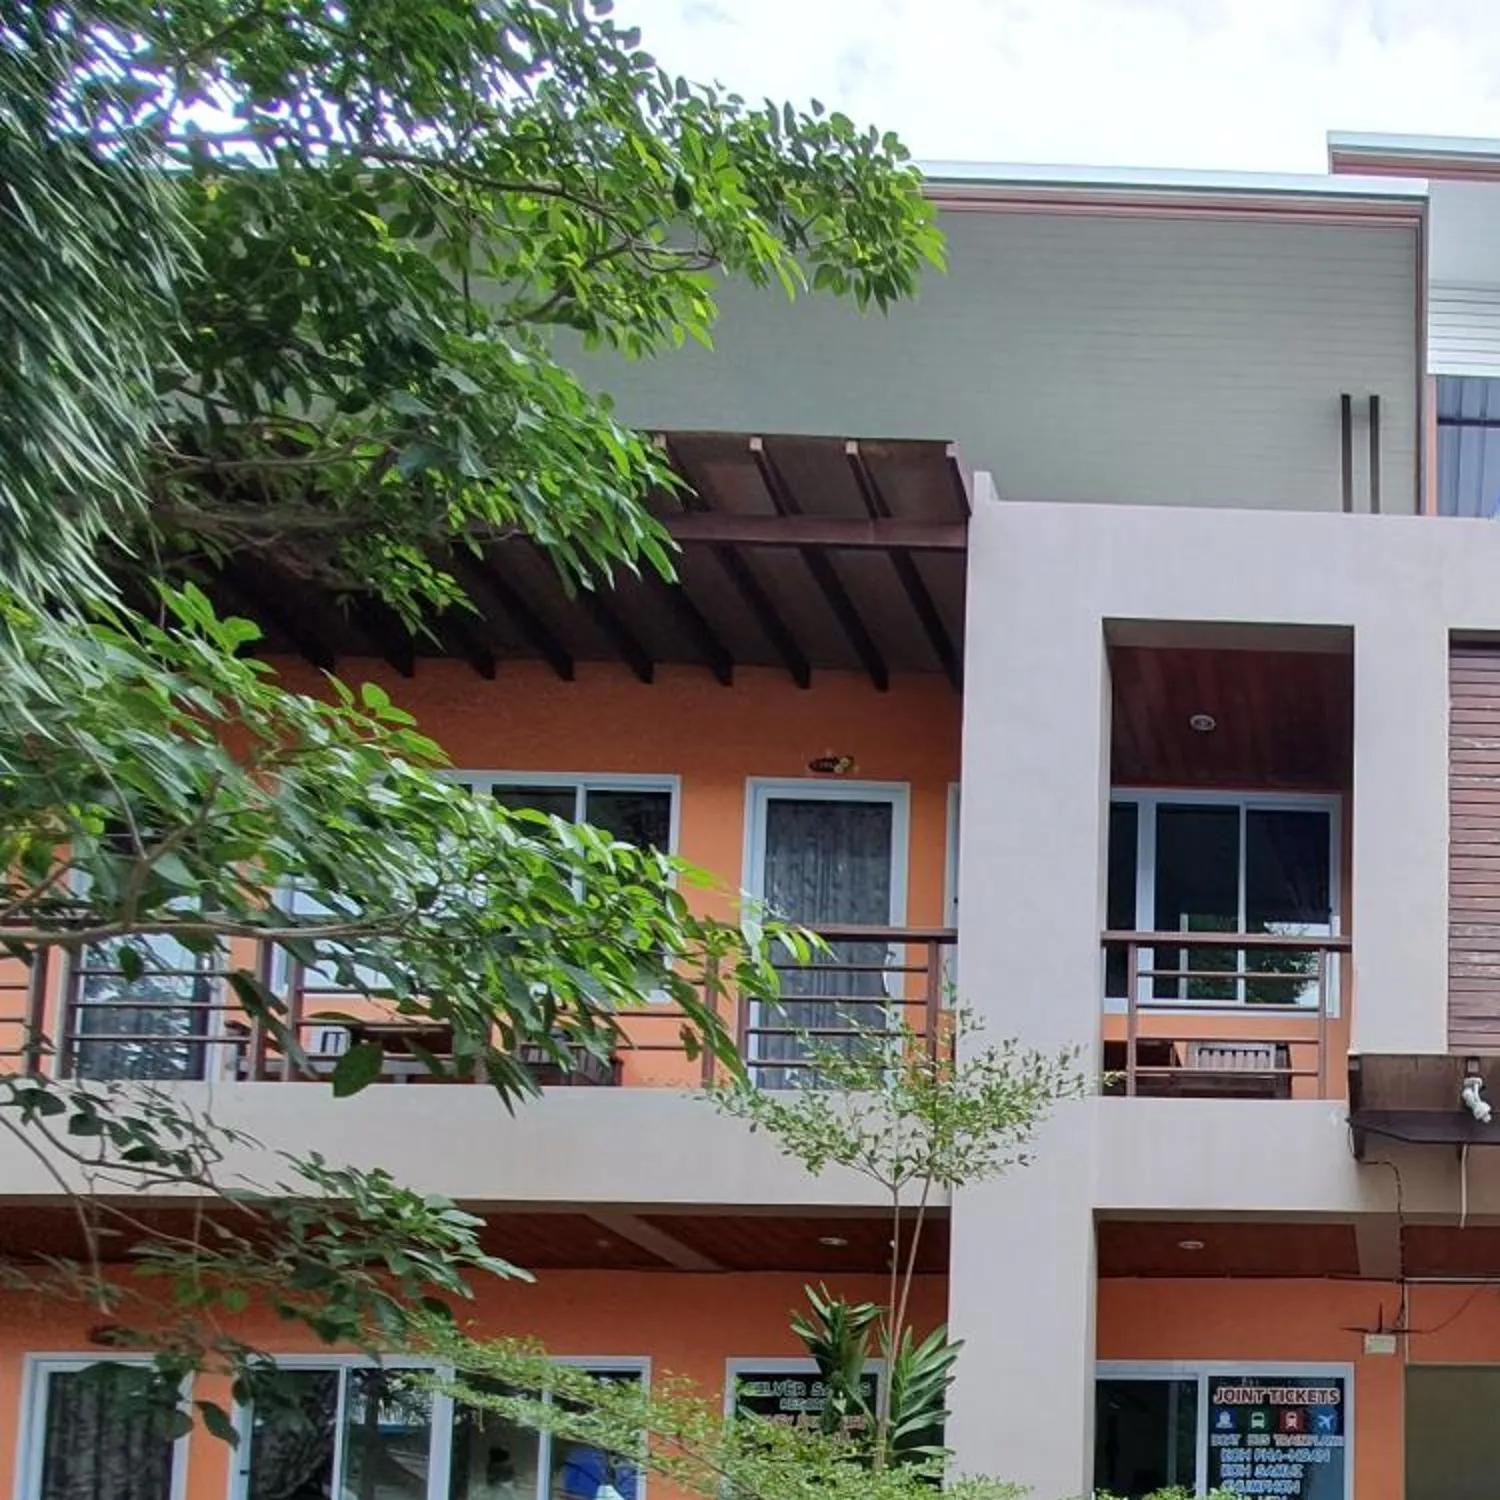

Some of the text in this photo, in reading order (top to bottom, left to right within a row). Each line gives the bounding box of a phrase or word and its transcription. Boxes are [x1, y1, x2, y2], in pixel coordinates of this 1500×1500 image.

[1213, 1387, 1341, 1405] JOINT TICKETS
[1221, 1448, 1252, 1462] KOH
[1221, 1464, 1252, 1478] KOH
